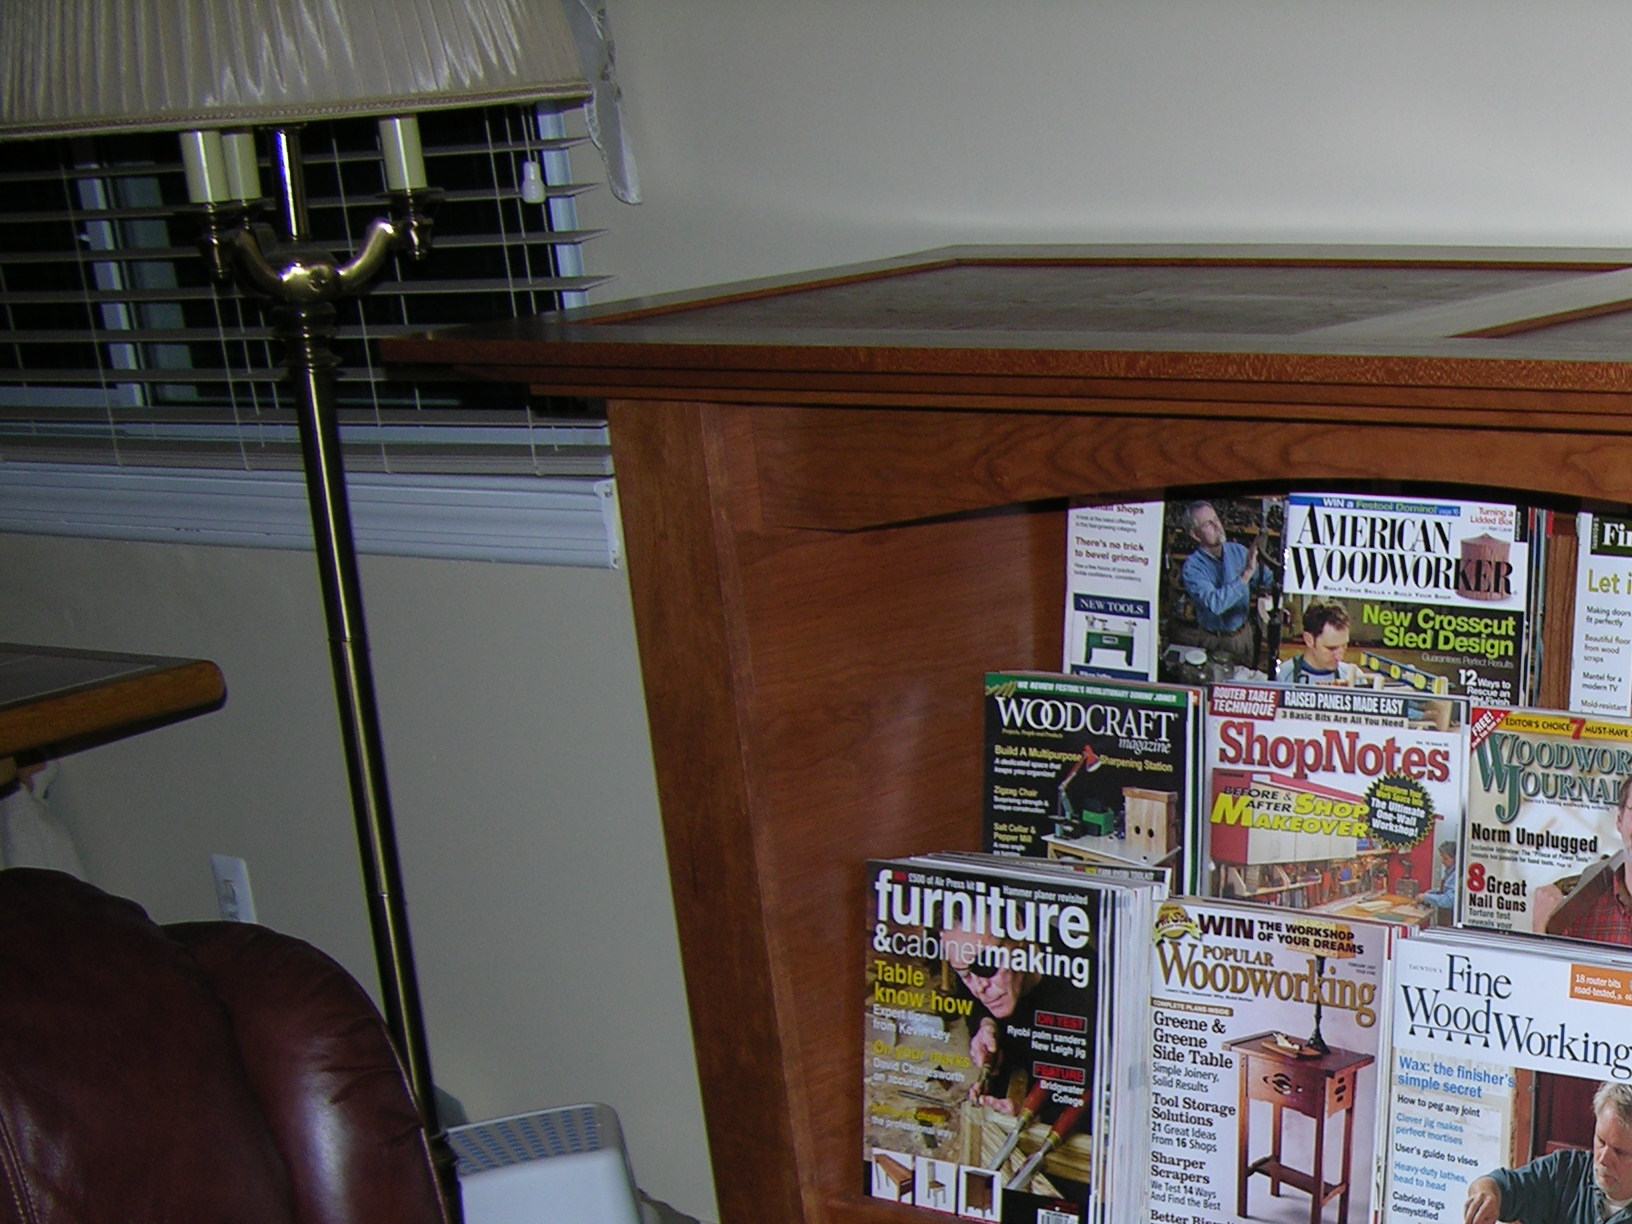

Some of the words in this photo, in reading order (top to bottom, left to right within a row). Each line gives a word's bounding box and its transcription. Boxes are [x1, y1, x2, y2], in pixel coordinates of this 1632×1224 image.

[1297, 502, 1453, 554] AMERICAN
[1290, 546, 1514, 596] WOODWORKER
[1587, 569, 1620, 595] Let
[1080, 598, 1107, 610] NEW
[1109, 601, 1144, 614] TOOLS
[1362, 604, 1411, 626] New
[1417, 608, 1515, 636] Crosscut
[1383, 626, 1433, 649] Sled
[1437, 630, 1514, 659] Design
[1213, 699, 1276, 717] TECHNIQUE
[1214, 687, 1247, 702] ROUTER
[1248, 689, 1276, 704] TABLE
[1284, 690, 1316, 709] RAISED
[1318, 692, 1351, 711] PANELS
[1353, 694, 1378, 713] MADE
[1379, 697, 1404, 715] EASY
[995, 696, 1176, 741] WOODCRAFT
[1505, 716, 1540, 730] EDITOR'S
[1542, 720, 1571, 732] CHOICE:
[1569, 718, 1586, 741] 7
[1585, 727, 1629, 738] MUST-HAVE
[994, 744, 1018, 755] Build
[1029, 747, 1083, 763] Multipurpose
[1100, 754, 1143, 771] Sharpening
[1144, 760, 1173, 773] Station
[1119, 737, 1172, 755] magazine
[1219, 720, 1450, 783] ShopNotes
[1224, 786, 1279, 800] BEFORE
[1283, 792, 1292, 801] &
[1245, 799, 1292, 813] AFTER
[1294, 793, 1371, 817] SHOP
[1210, 792, 1369, 839] MAKEOVER
[1471, 822, 1510, 844] Norm
[1516, 828, 1598, 855] Unplugged
[1467, 862, 1486, 892] 8
[1487, 875, 1527, 897] Great
[874, 868, 1090, 949] furniture
[1469, 893, 1494, 909] Nail
[1497, 897, 1527, 913] Guns
[1197, 914, 1254, 940] WIN
[1258, 920, 1282, 932] THE
[1286, 923, 1355, 941] WORKSHOP
[872, 922, 1090, 989] &cabinetmaking
[1202, 945, 1274, 967] POPULAR
[1258, 931, 1274, 942] OF
[1279, 934, 1311, 948] YOUR
[1313, 939, 1364, 955] DREAMS
[874, 960, 925, 987] Table
[1156, 941, 1377, 1028] Woodworking
[1445, 953, 1512, 1000] Fine
[874, 982, 924, 1010] know
[929, 990, 974, 1018] how
[1154, 1011, 1208, 1031] Greene
[1213, 1020, 1226, 1033] &
[1154, 1028, 1208, 1048] Greene
[1153, 1045, 1185, 1062] Side
[1189, 1050, 1233, 1069] Table
[1398, 1056, 1430, 1073] Wax:
[1433, 1062, 1454, 1077] the
[1456, 1065, 1515, 1088] finisher's
[1398, 1073, 1441, 1093] simple
[1443, 1081, 1483, 1098] secret
[1150, 1210, 1189, 1224] Better
